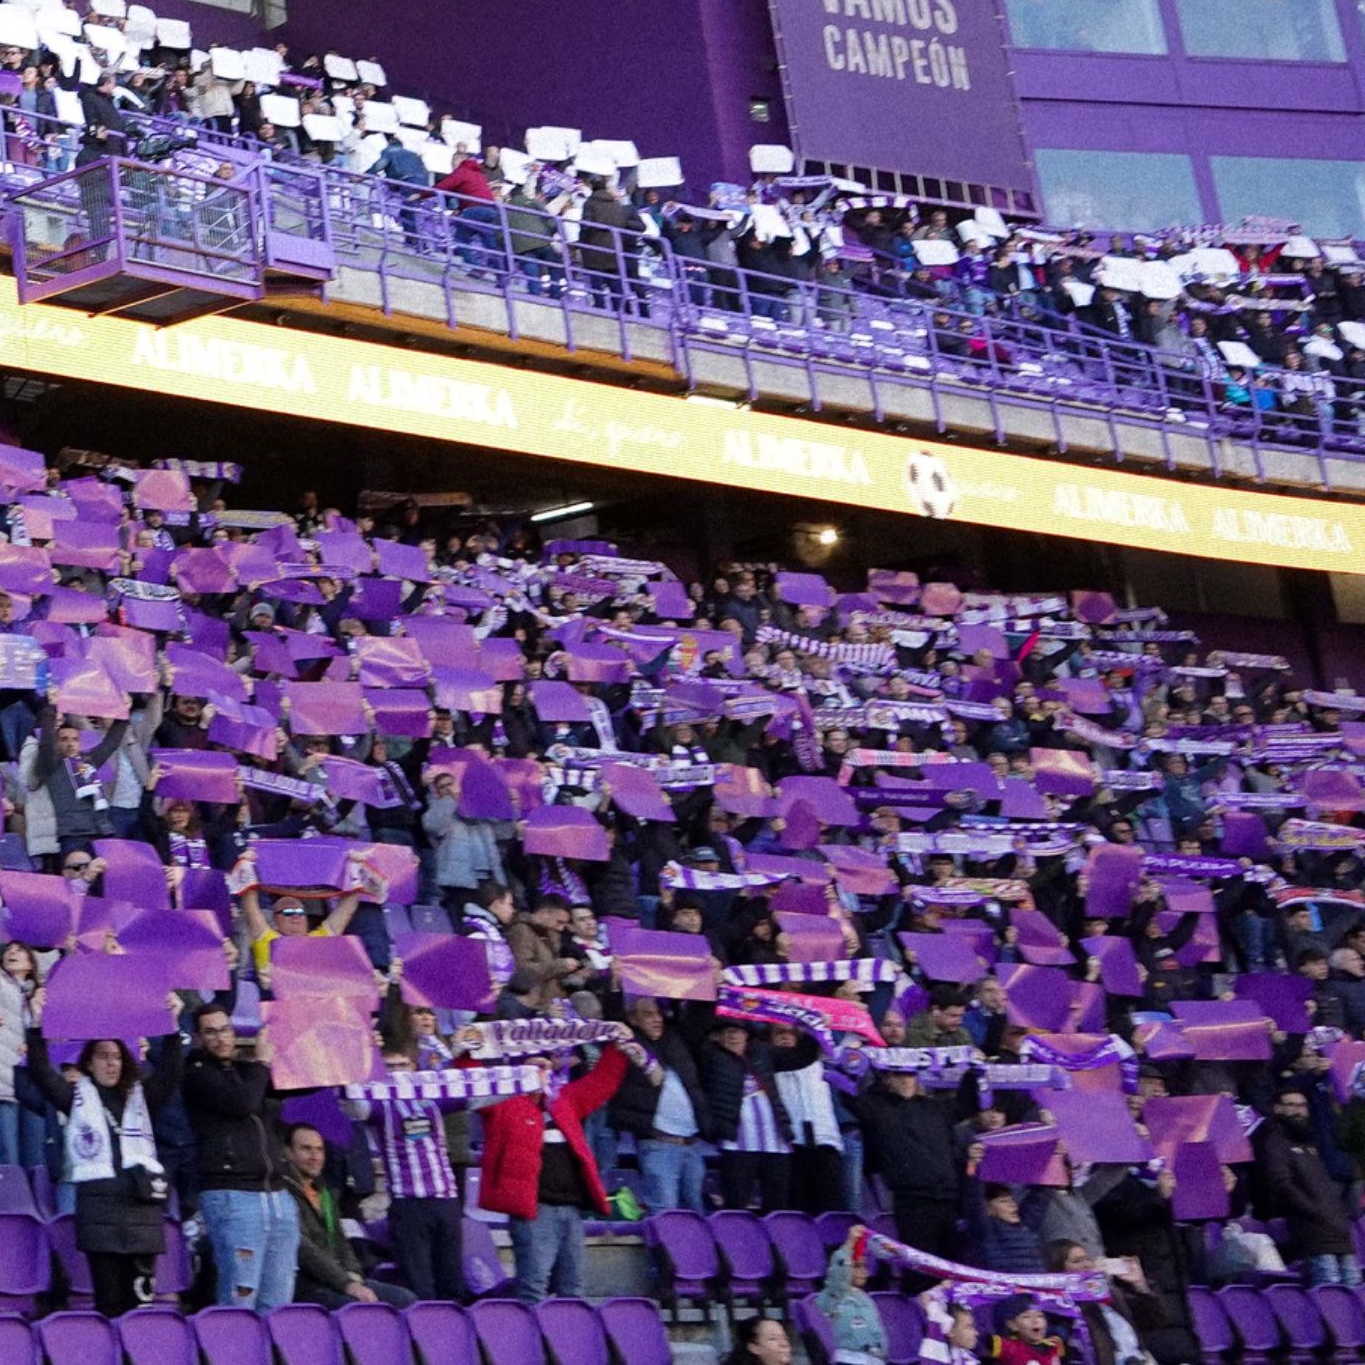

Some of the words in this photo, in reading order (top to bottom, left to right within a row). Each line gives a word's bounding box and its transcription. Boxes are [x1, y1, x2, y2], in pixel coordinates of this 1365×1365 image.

[823, 24, 971, 91] CAMPEÓN
[131, 326, 318, 396] ALIMERKA
[347, 363, 520, 430] ALIMERKA
[721, 427, 876, 487] ALIMERKA
[1052, 482, 1191, 535] ALIMERKA
[1211, 506, 1353, 554] ALIMERKA
